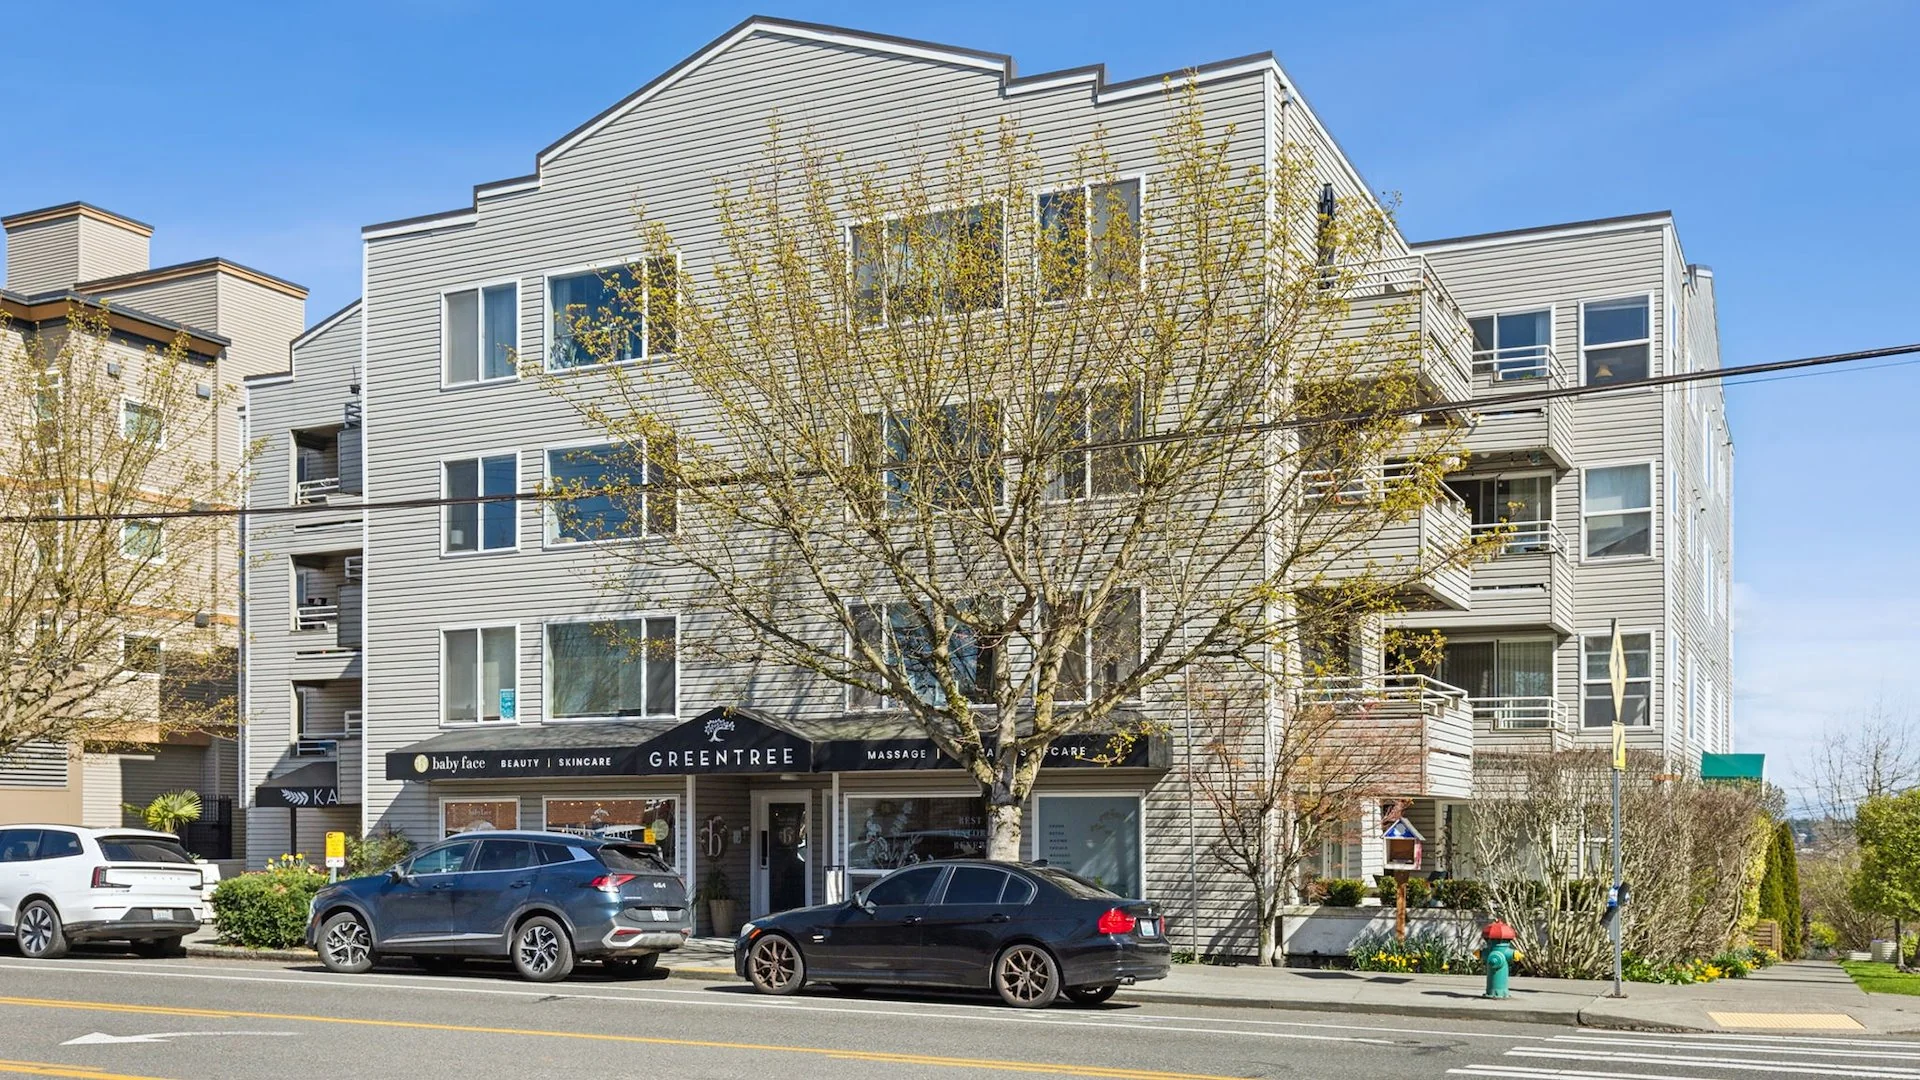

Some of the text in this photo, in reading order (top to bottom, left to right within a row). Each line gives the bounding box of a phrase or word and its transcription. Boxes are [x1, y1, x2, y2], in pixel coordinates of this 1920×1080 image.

[649, 748, 794, 767] GREENTREE
[867, 749, 926, 760] MASSAGE
[1020, 746, 1086, 757] SCARE
[432, 755, 459, 773] baby
[461, 755, 486, 770] face
[500, 757, 611, 768] BEAUTY SKINCARE
[949, 829, 986, 837] RESTOR
